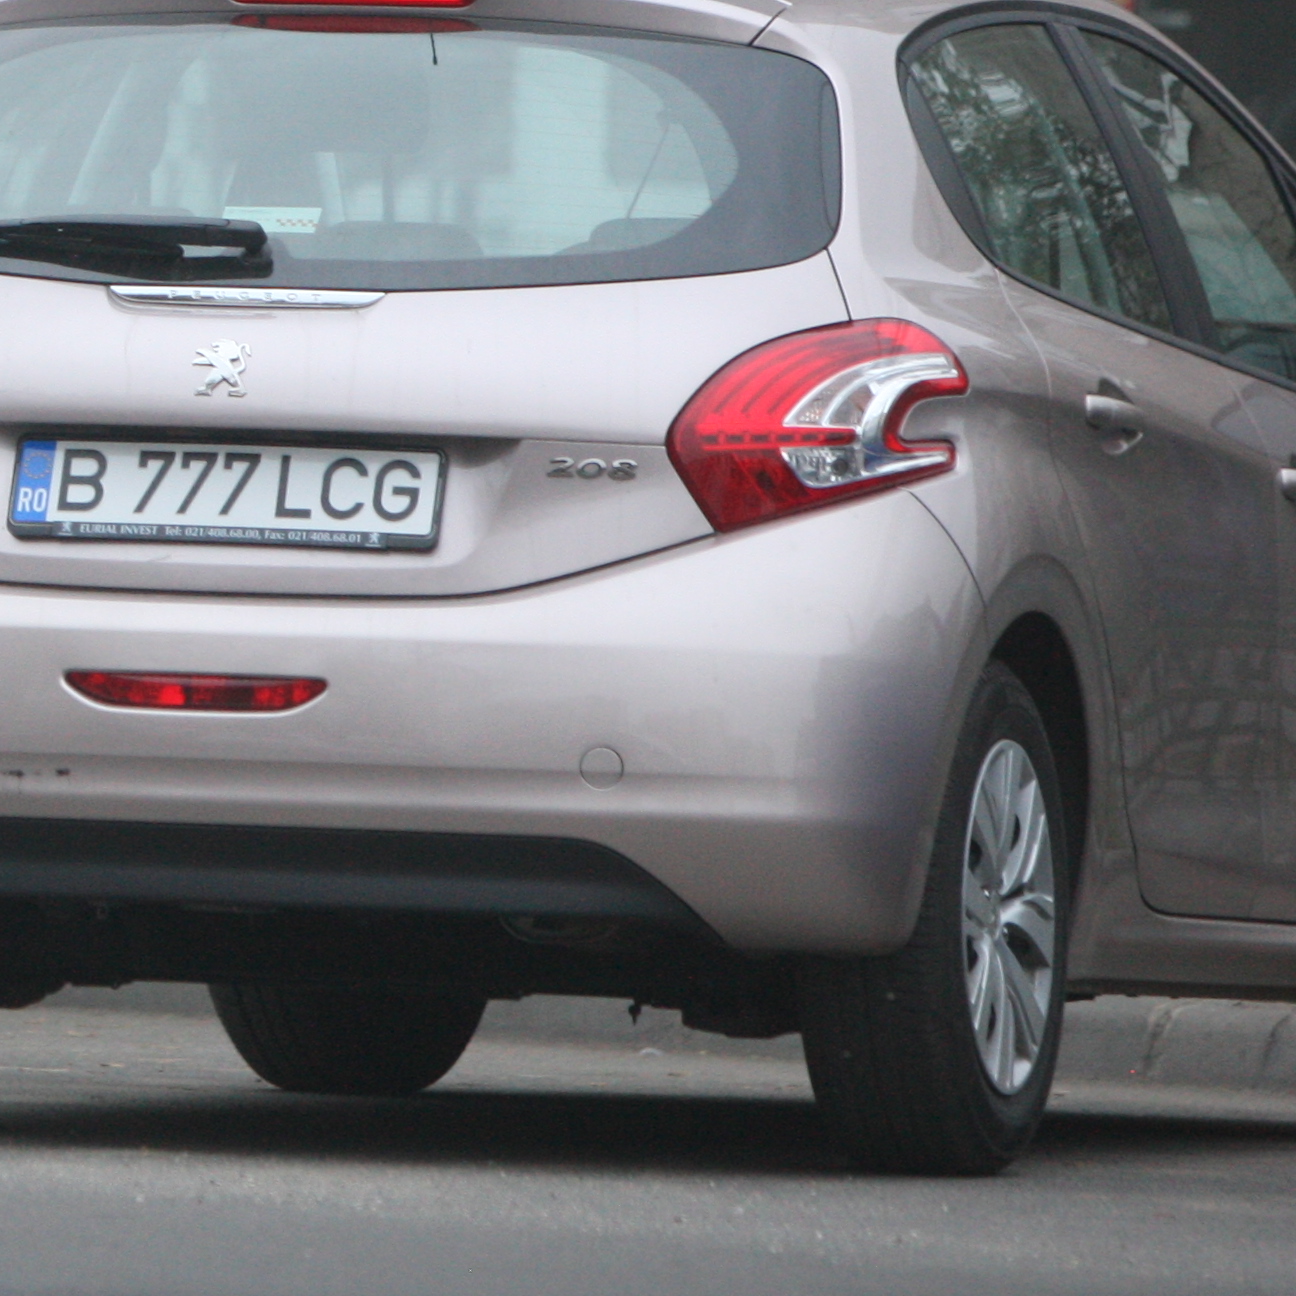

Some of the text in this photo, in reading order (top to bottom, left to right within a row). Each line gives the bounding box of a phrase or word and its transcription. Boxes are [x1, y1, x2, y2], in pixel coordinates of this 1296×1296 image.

[167, 289, 322, 302] PEUGEOT
[546, 456, 638, 481] 208
[57, 448, 422, 523] B 777 LCG
[16, 487, 47, 513] RO
[120, 524, 158, 535] INVEST
